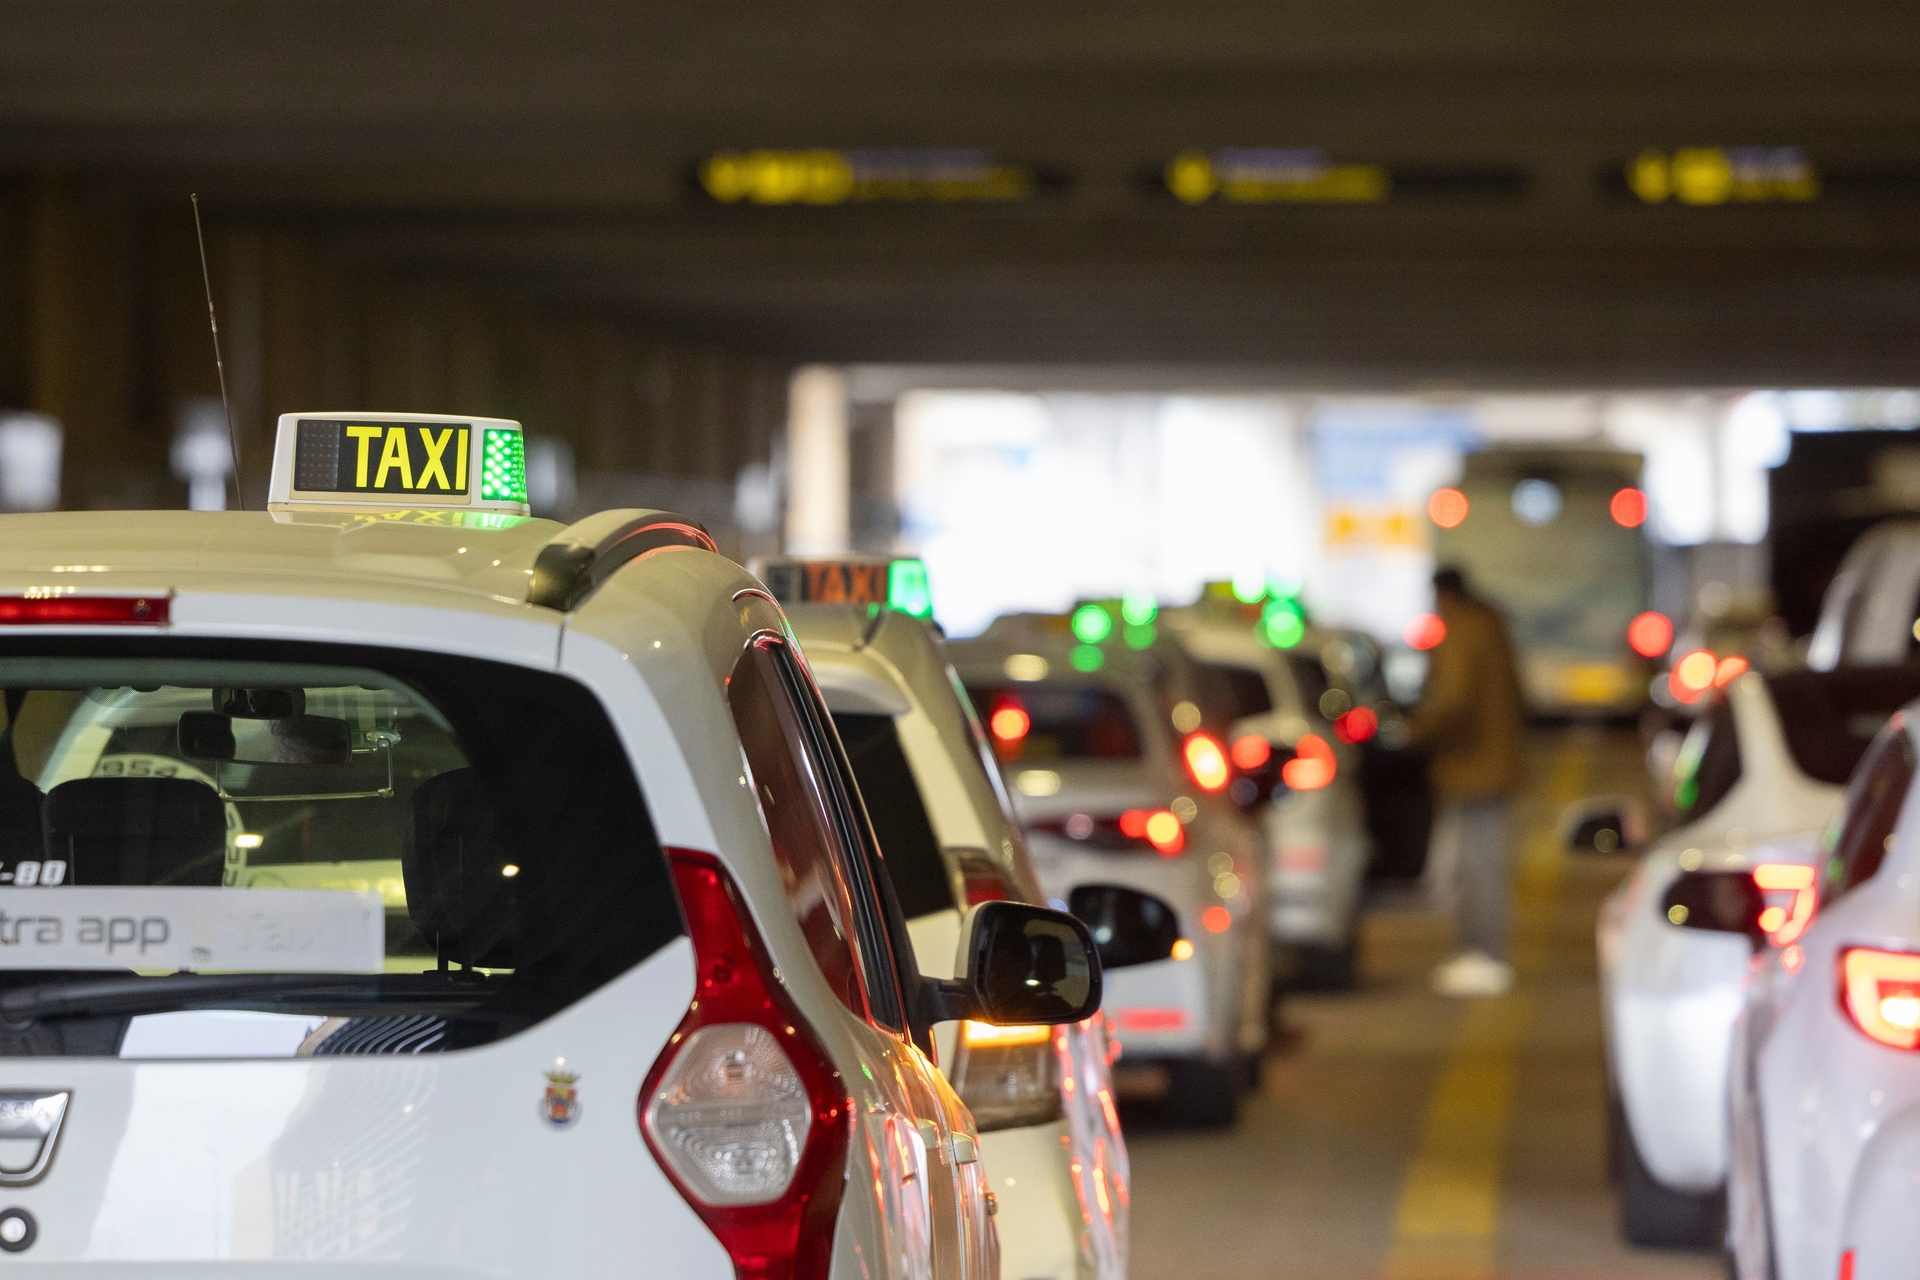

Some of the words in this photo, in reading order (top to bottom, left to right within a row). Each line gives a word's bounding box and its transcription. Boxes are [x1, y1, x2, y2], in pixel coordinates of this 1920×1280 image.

[346, 426, 469, 491] TAXI
[805, 561, 889, 604] TAXI
[0, 860, 67, 886] -80
[77, 916, 170, 954] app
